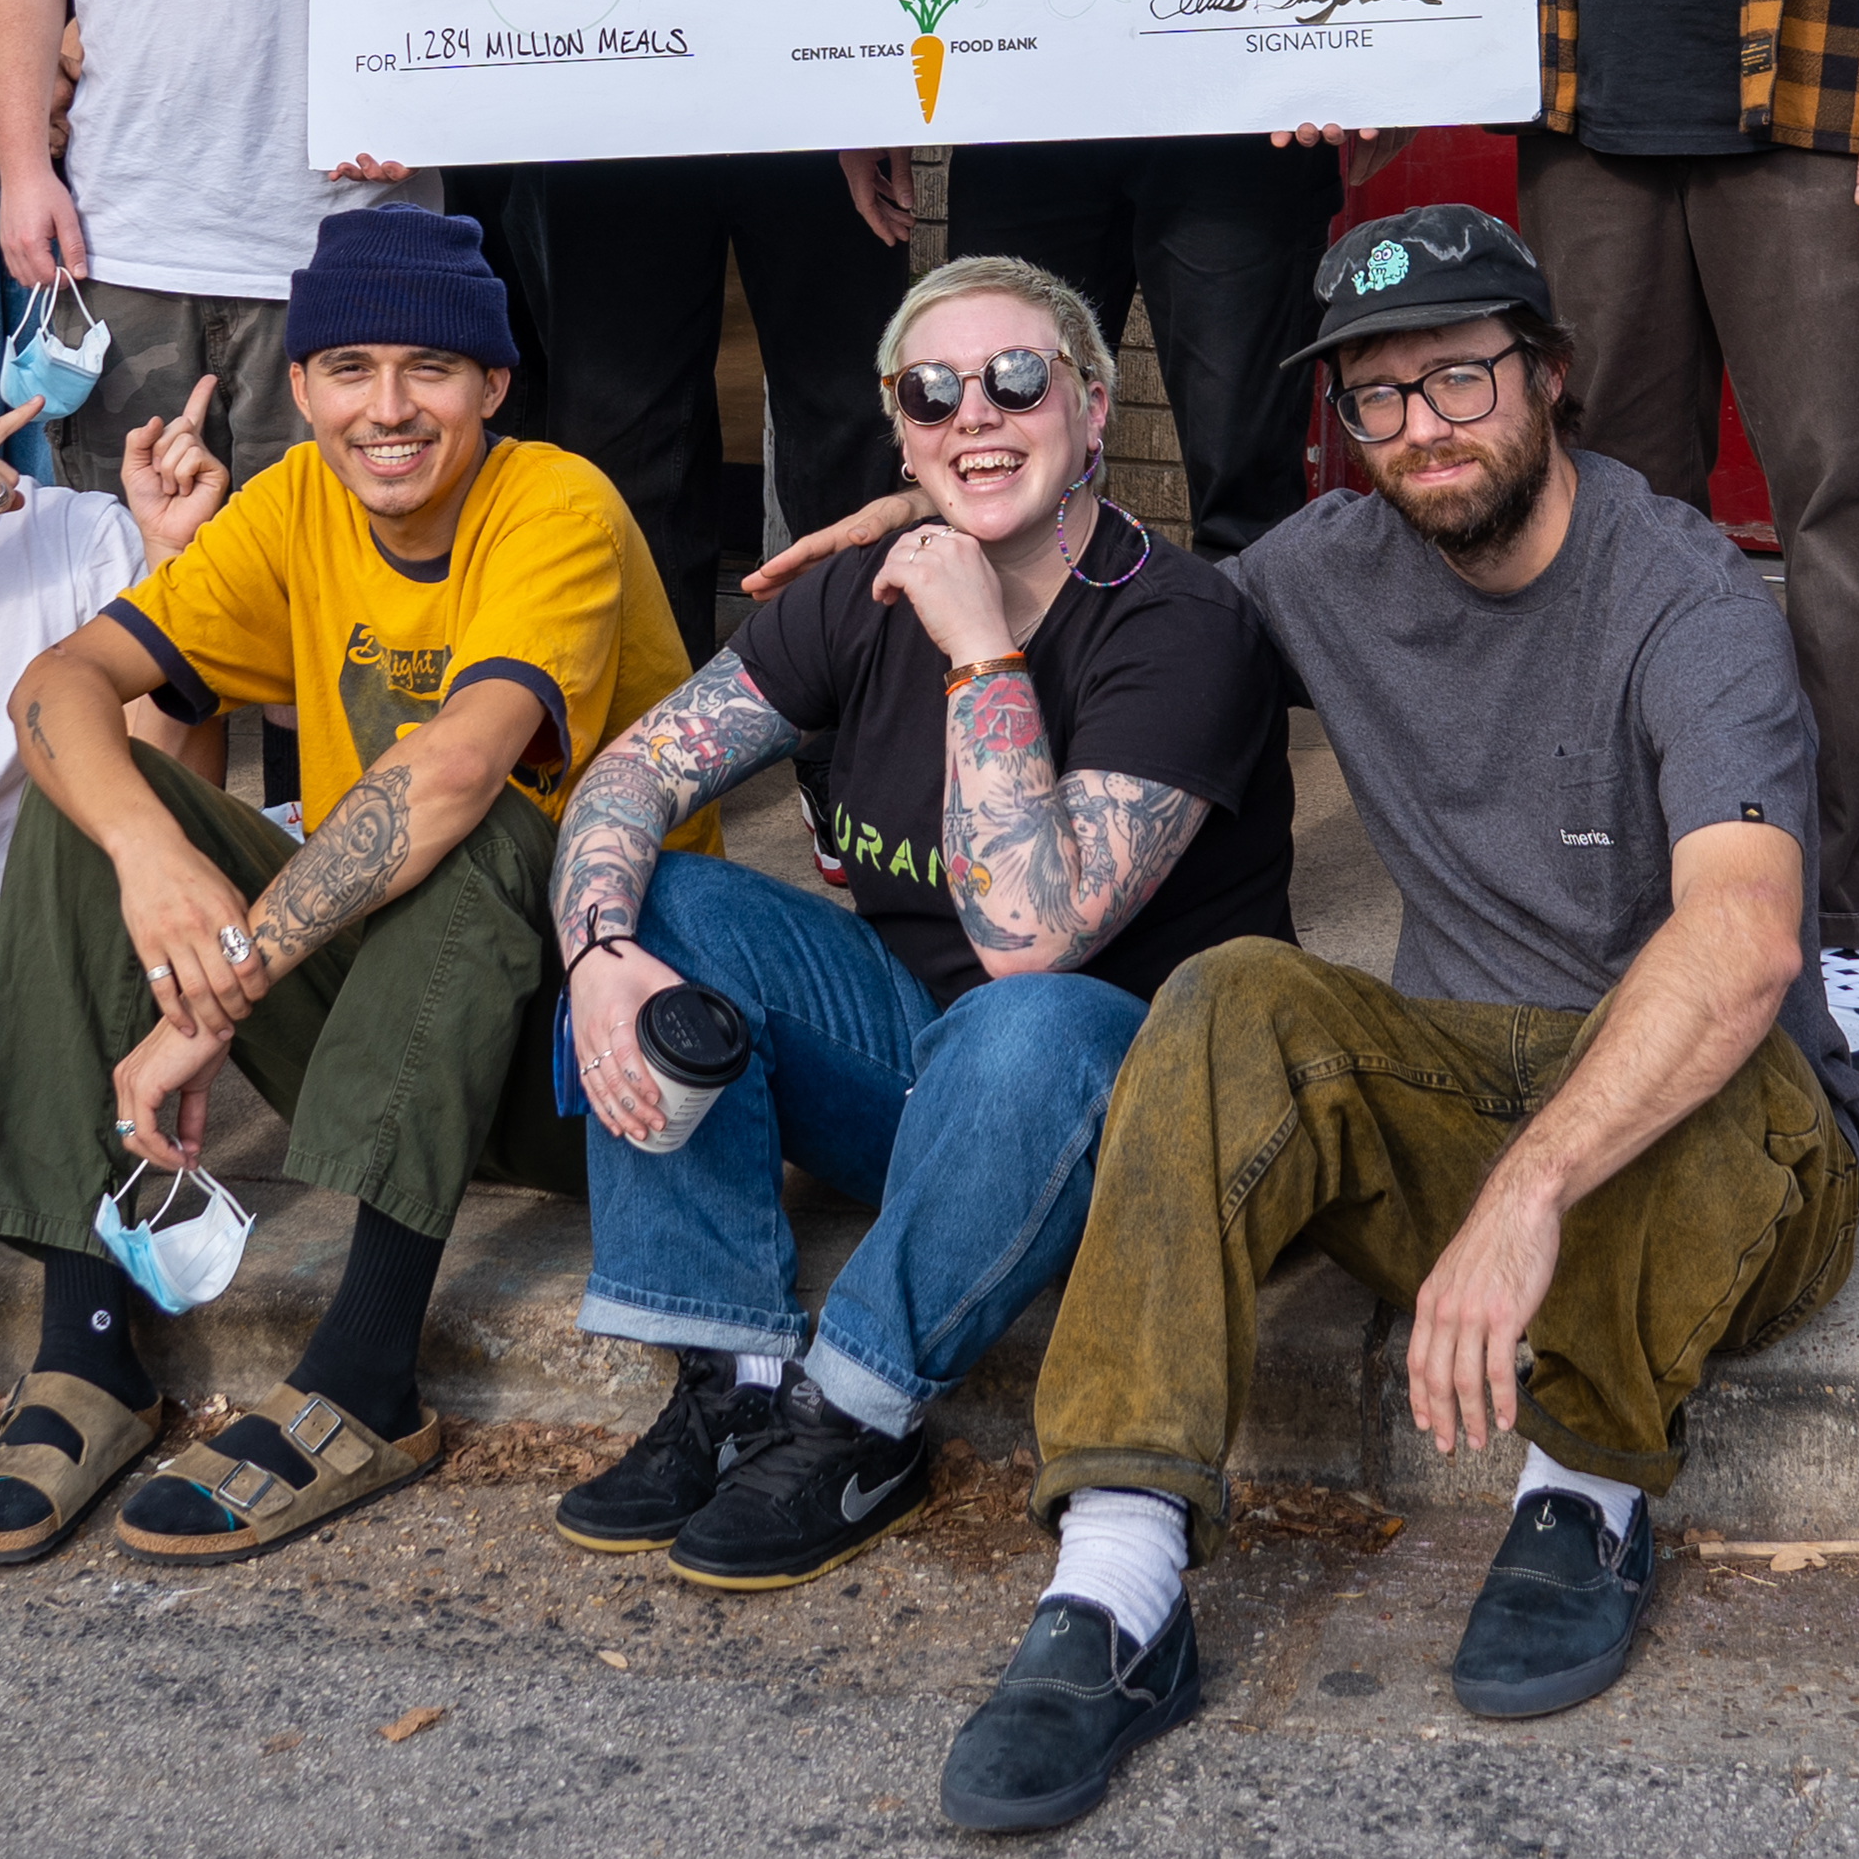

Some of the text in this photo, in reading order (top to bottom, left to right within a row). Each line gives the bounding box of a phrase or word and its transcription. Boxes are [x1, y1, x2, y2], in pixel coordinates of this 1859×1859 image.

[405, 26, 690, 65] 1.284 MILLION MEALS
[791, 35, 1039, 62] CENTRAL TEXAS FOOD BANK
[1245, 28, 1374, 55] SIGNATURE
[355, 52, 397, 75] FOR
